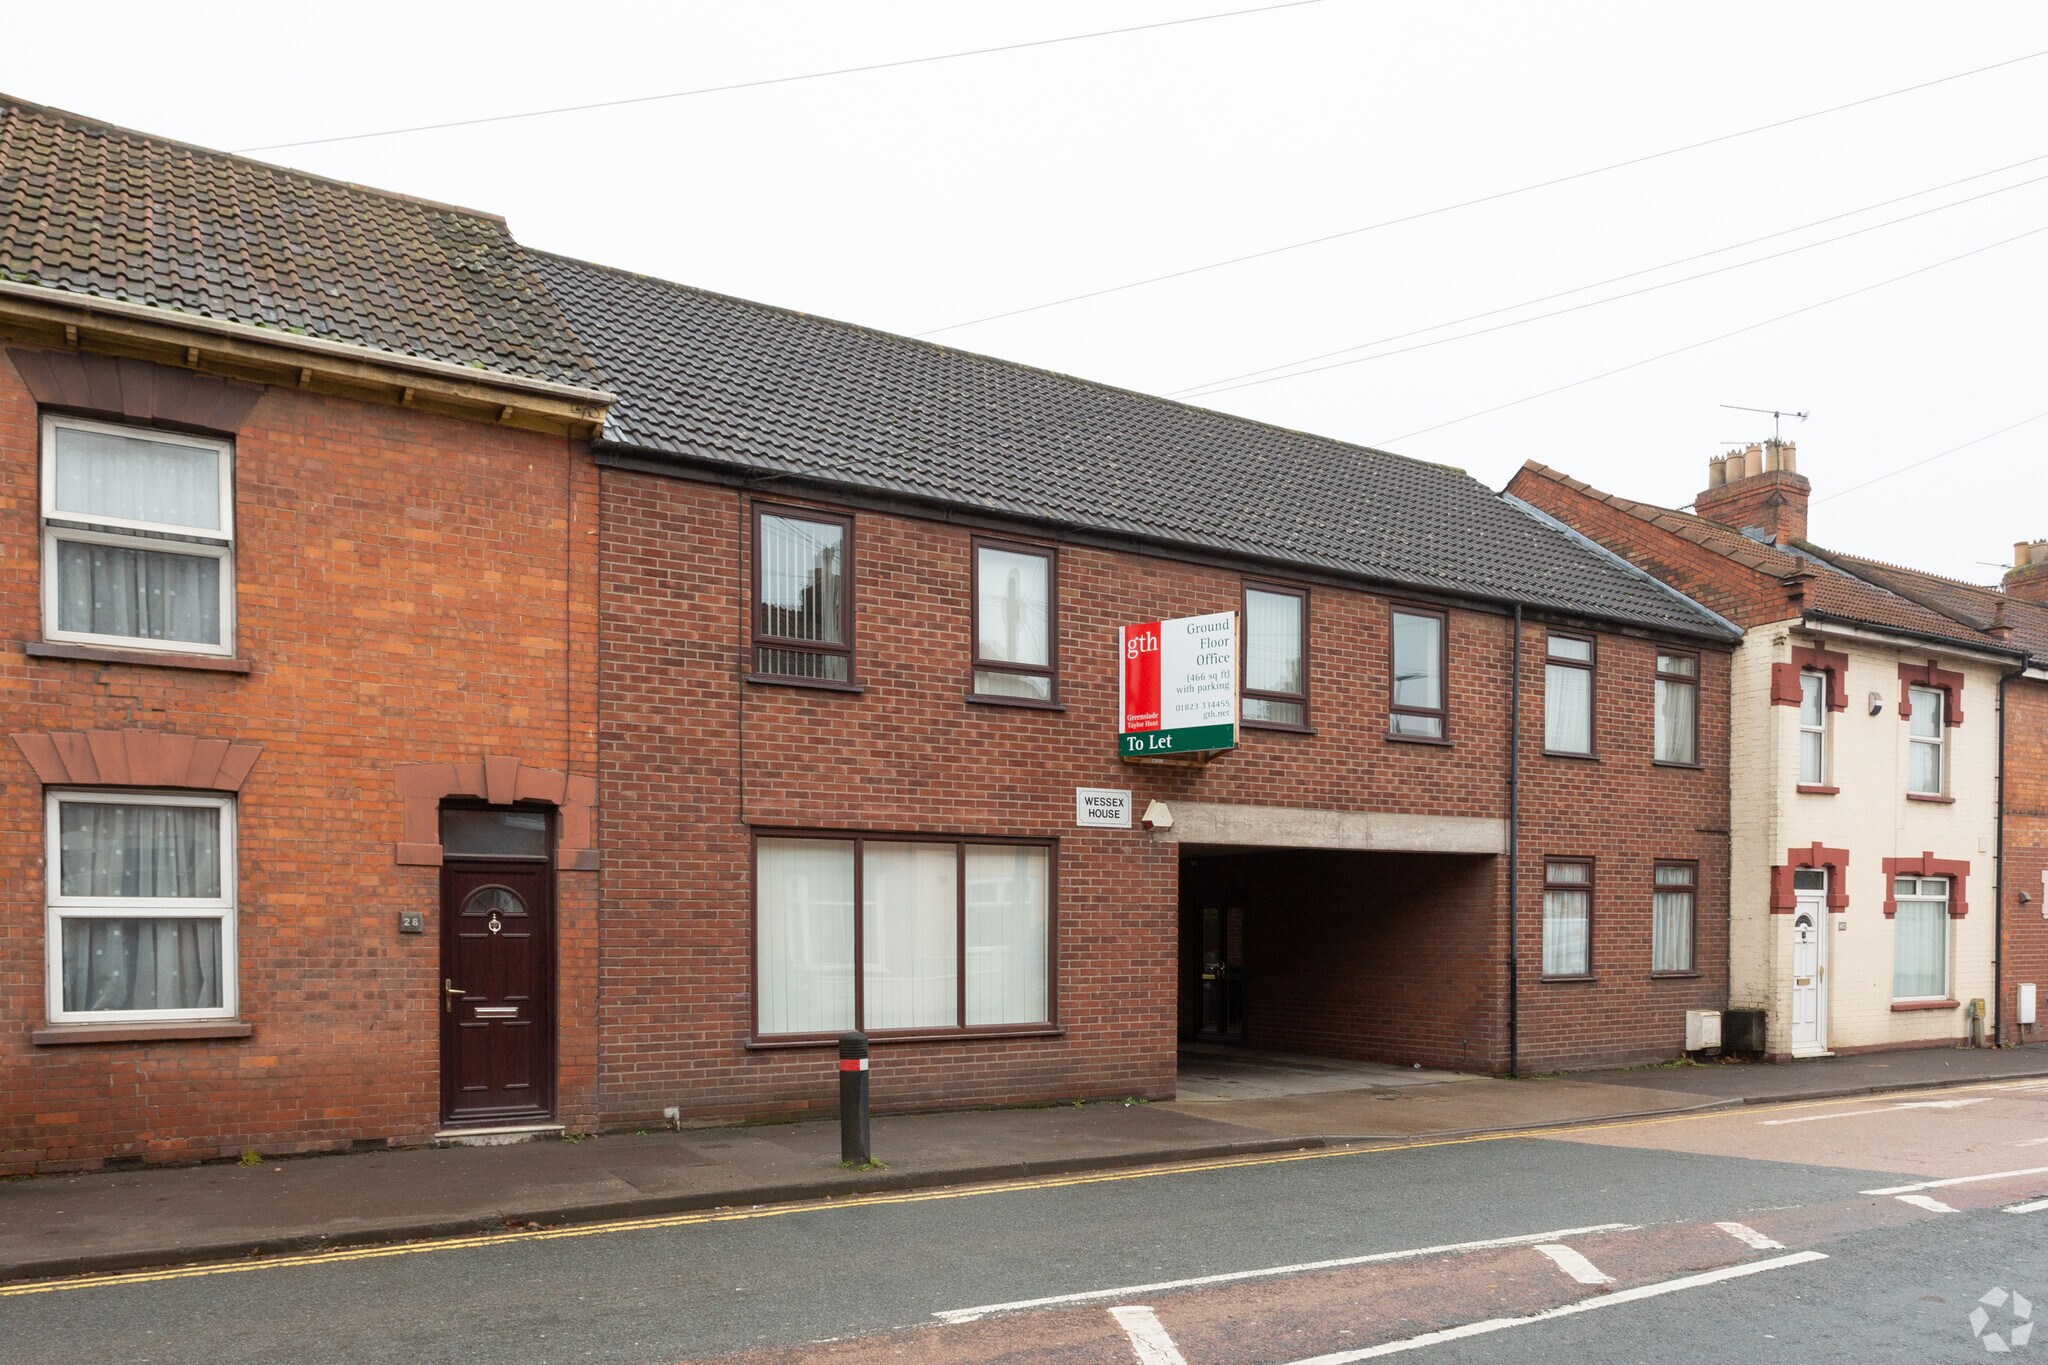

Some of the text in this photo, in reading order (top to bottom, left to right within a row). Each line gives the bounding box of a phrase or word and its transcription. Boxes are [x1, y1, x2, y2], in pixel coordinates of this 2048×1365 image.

[1187, 618, 1229, 635] Ground
[1127, 631, 1158, 659] gth
[1200, 637, 1230, 649] Floor
[1196, 652, 1230, 666] Office
[1186, 669, 1230, 683] (466 sq ft)
[1176, 681, 1230, 694] with parking
[1175, 700, 1230, 711] 01823 334455
[1126, 712, 1159, 721] Greenslade
[1203, 710, 1230, 720] gth.net
[1127, 720, 1159, 729] Taylor Hunt
[1126, 734, 1172, 751] To Let
[1084, 796, 1124, 807] WESSEX
[1088, 809, 1120, 818] HOUSE
[403, 917, 419, 926] 28
